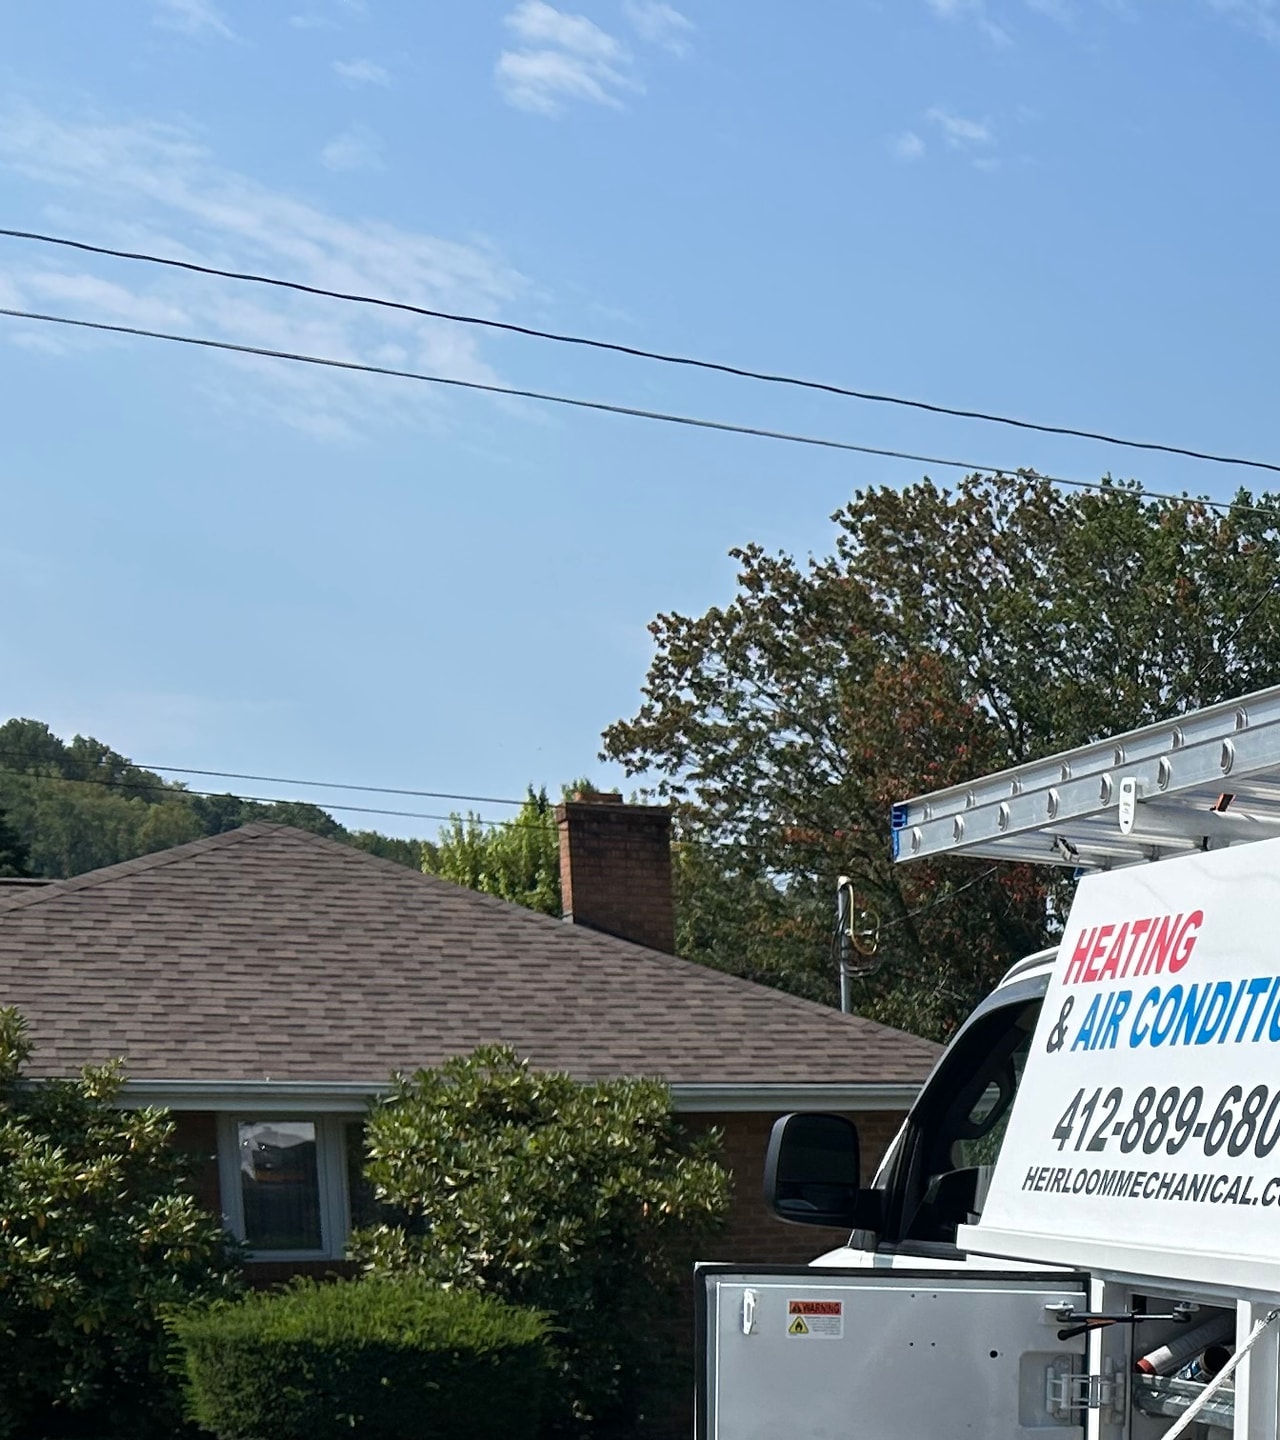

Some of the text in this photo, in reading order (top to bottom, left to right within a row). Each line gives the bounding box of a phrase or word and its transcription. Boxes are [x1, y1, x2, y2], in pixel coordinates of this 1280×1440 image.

[1062, 909, 1204, 986] HEATING
[1046, 994, 1076, 1054] &
[1069, 989, 1133, 1052] AIR
